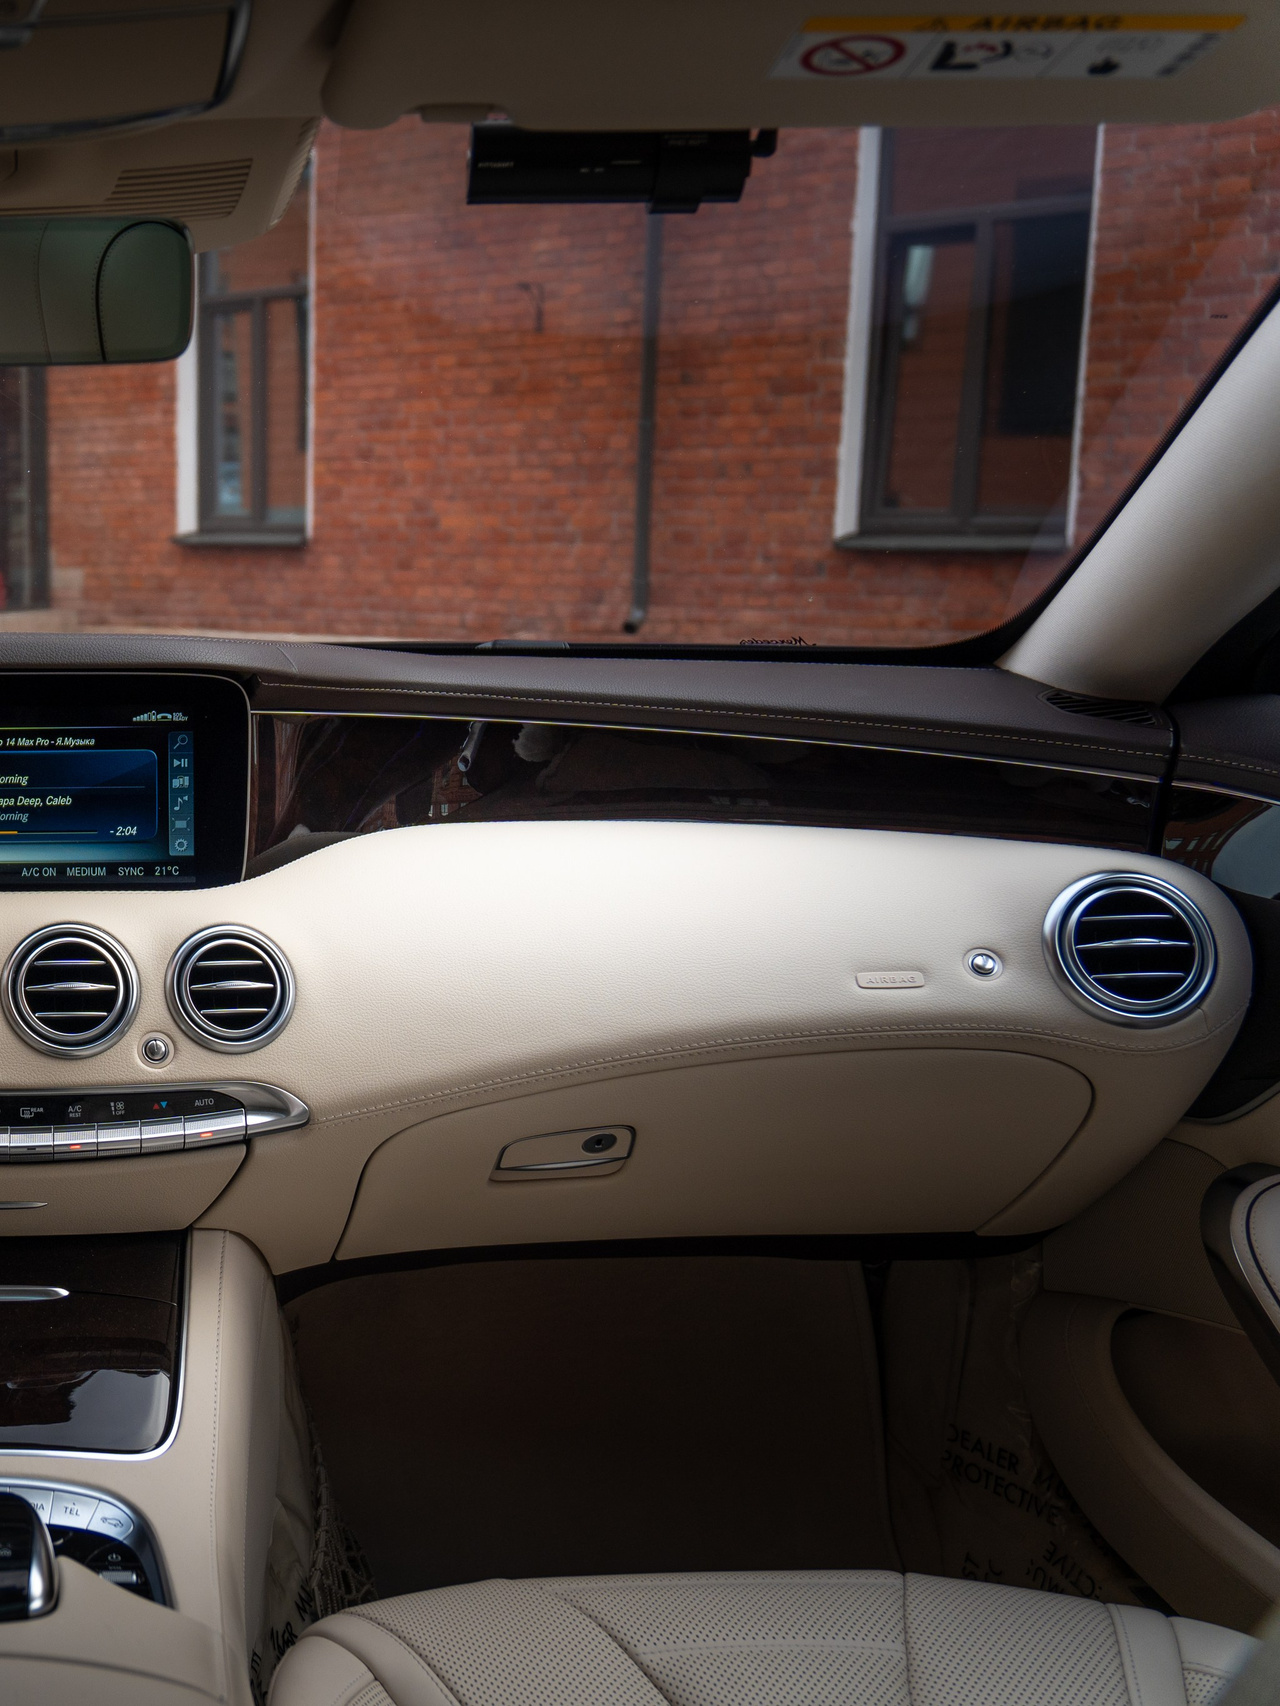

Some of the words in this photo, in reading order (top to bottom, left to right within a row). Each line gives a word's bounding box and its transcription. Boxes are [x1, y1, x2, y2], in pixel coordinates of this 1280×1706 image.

[969, 16, 1123, 31] AIRBAG
[6, 738, 16, 746] 14
[17, 738, 34, 746] Max
[36, 738, 50, 746] Pro
[17, 796, 43, 807] Deep,
[46, 795, 72, 805] Caleb
[116, 827, 138, 836] 2:04
[22, 868, 40, 877] A/C
[43, 868, 56, 876] ON
[67, 867, 106, 876] MEDIUM
[118, 867, 144, 876] SYNC
[155, 866, 179, 875] 21°C
[866, 975, 916, 985] AIRBAG
[194, 1098, 214, 1107] AUTO
[64, 1506, 80, 1516] TEL
